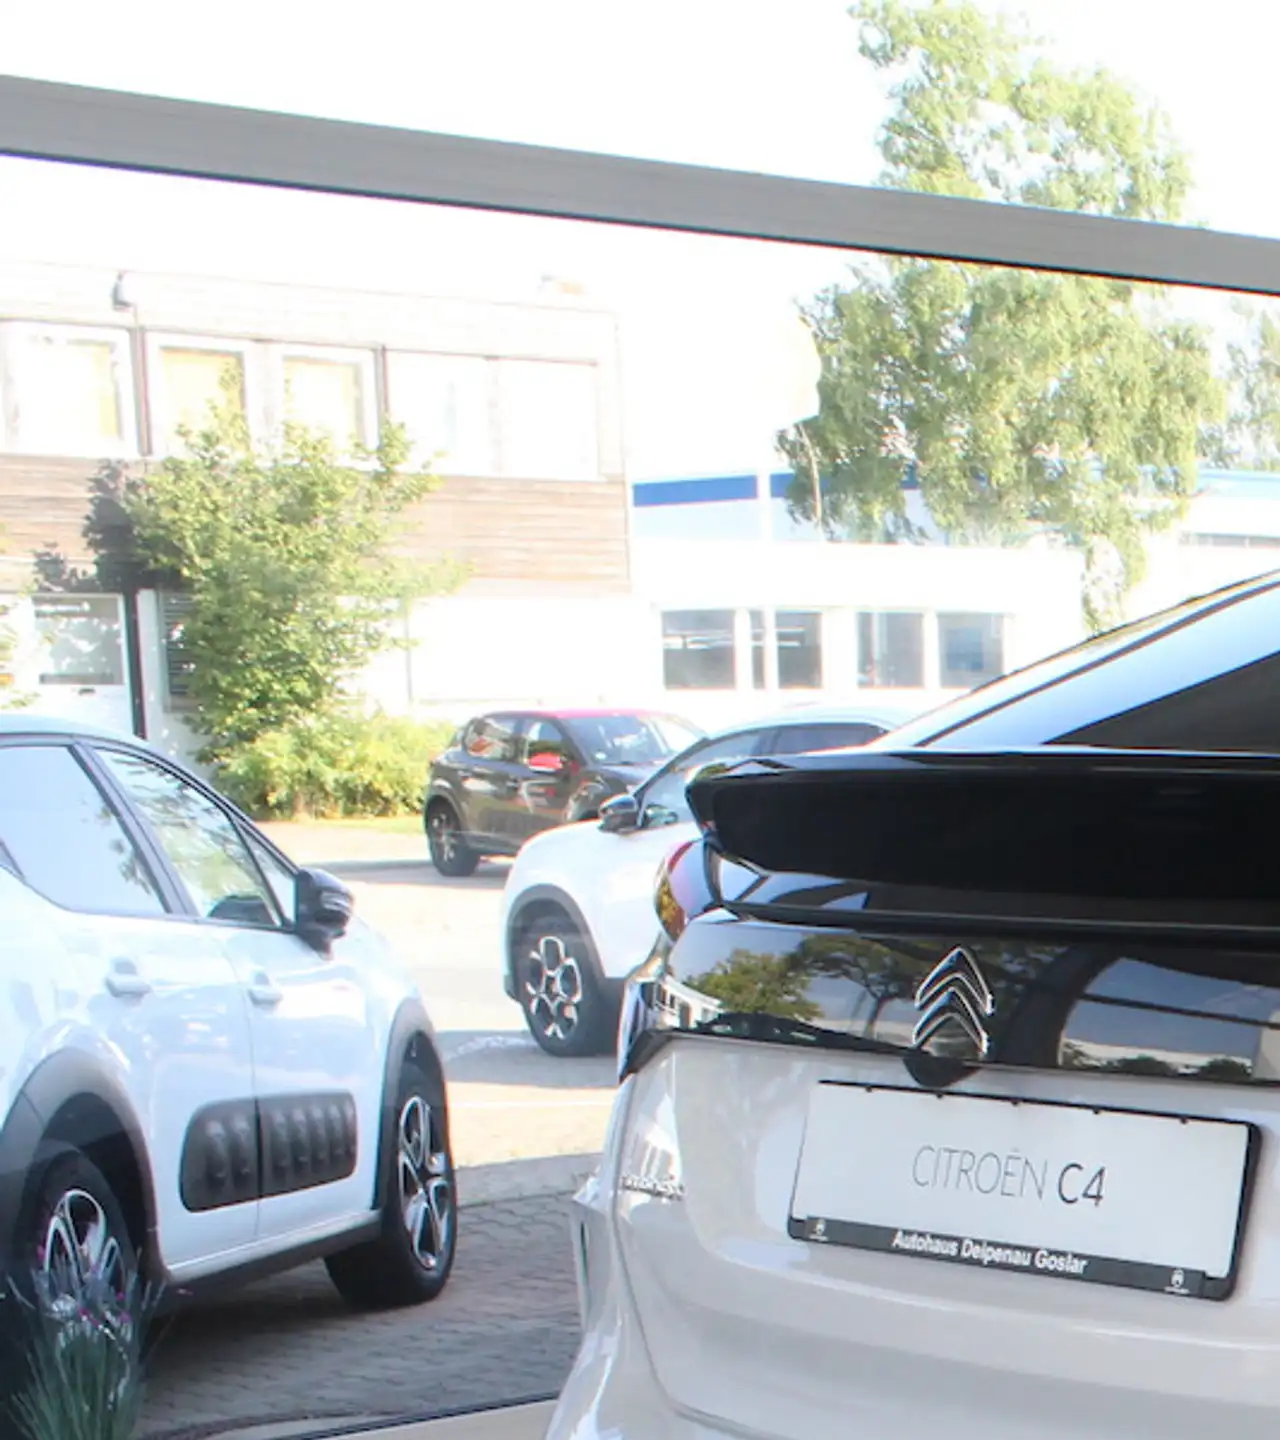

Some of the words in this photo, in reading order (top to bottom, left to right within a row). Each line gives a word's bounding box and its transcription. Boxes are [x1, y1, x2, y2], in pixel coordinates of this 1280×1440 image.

[912, 1145, 1048, 1200] CITROËN
[1057, 1162, 1106, 1207] C4
[892, 1230, 958, 1257] Autohaus
[1034, 1250, 1089, 1275] Goslar
